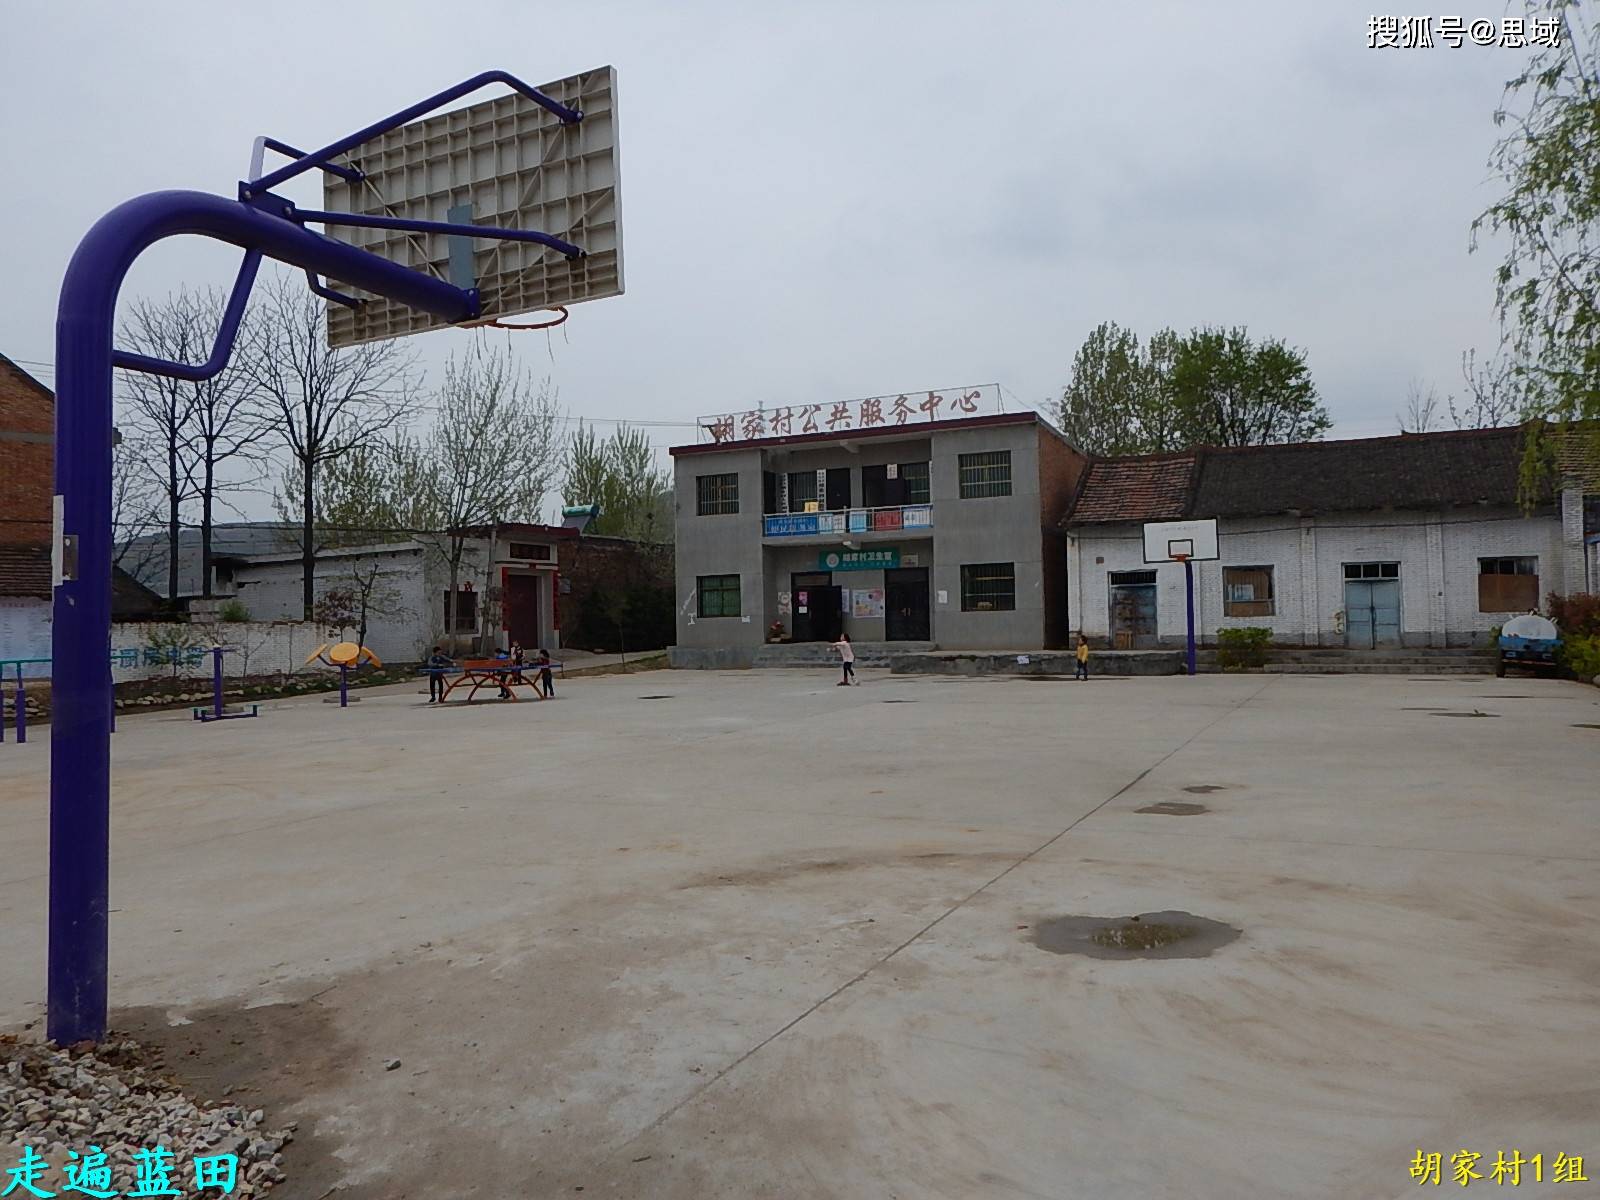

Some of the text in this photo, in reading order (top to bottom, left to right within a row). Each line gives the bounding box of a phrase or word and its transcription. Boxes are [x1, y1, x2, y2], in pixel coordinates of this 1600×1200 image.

[713, 391, 981, 442] 胡家村公共服务中心
